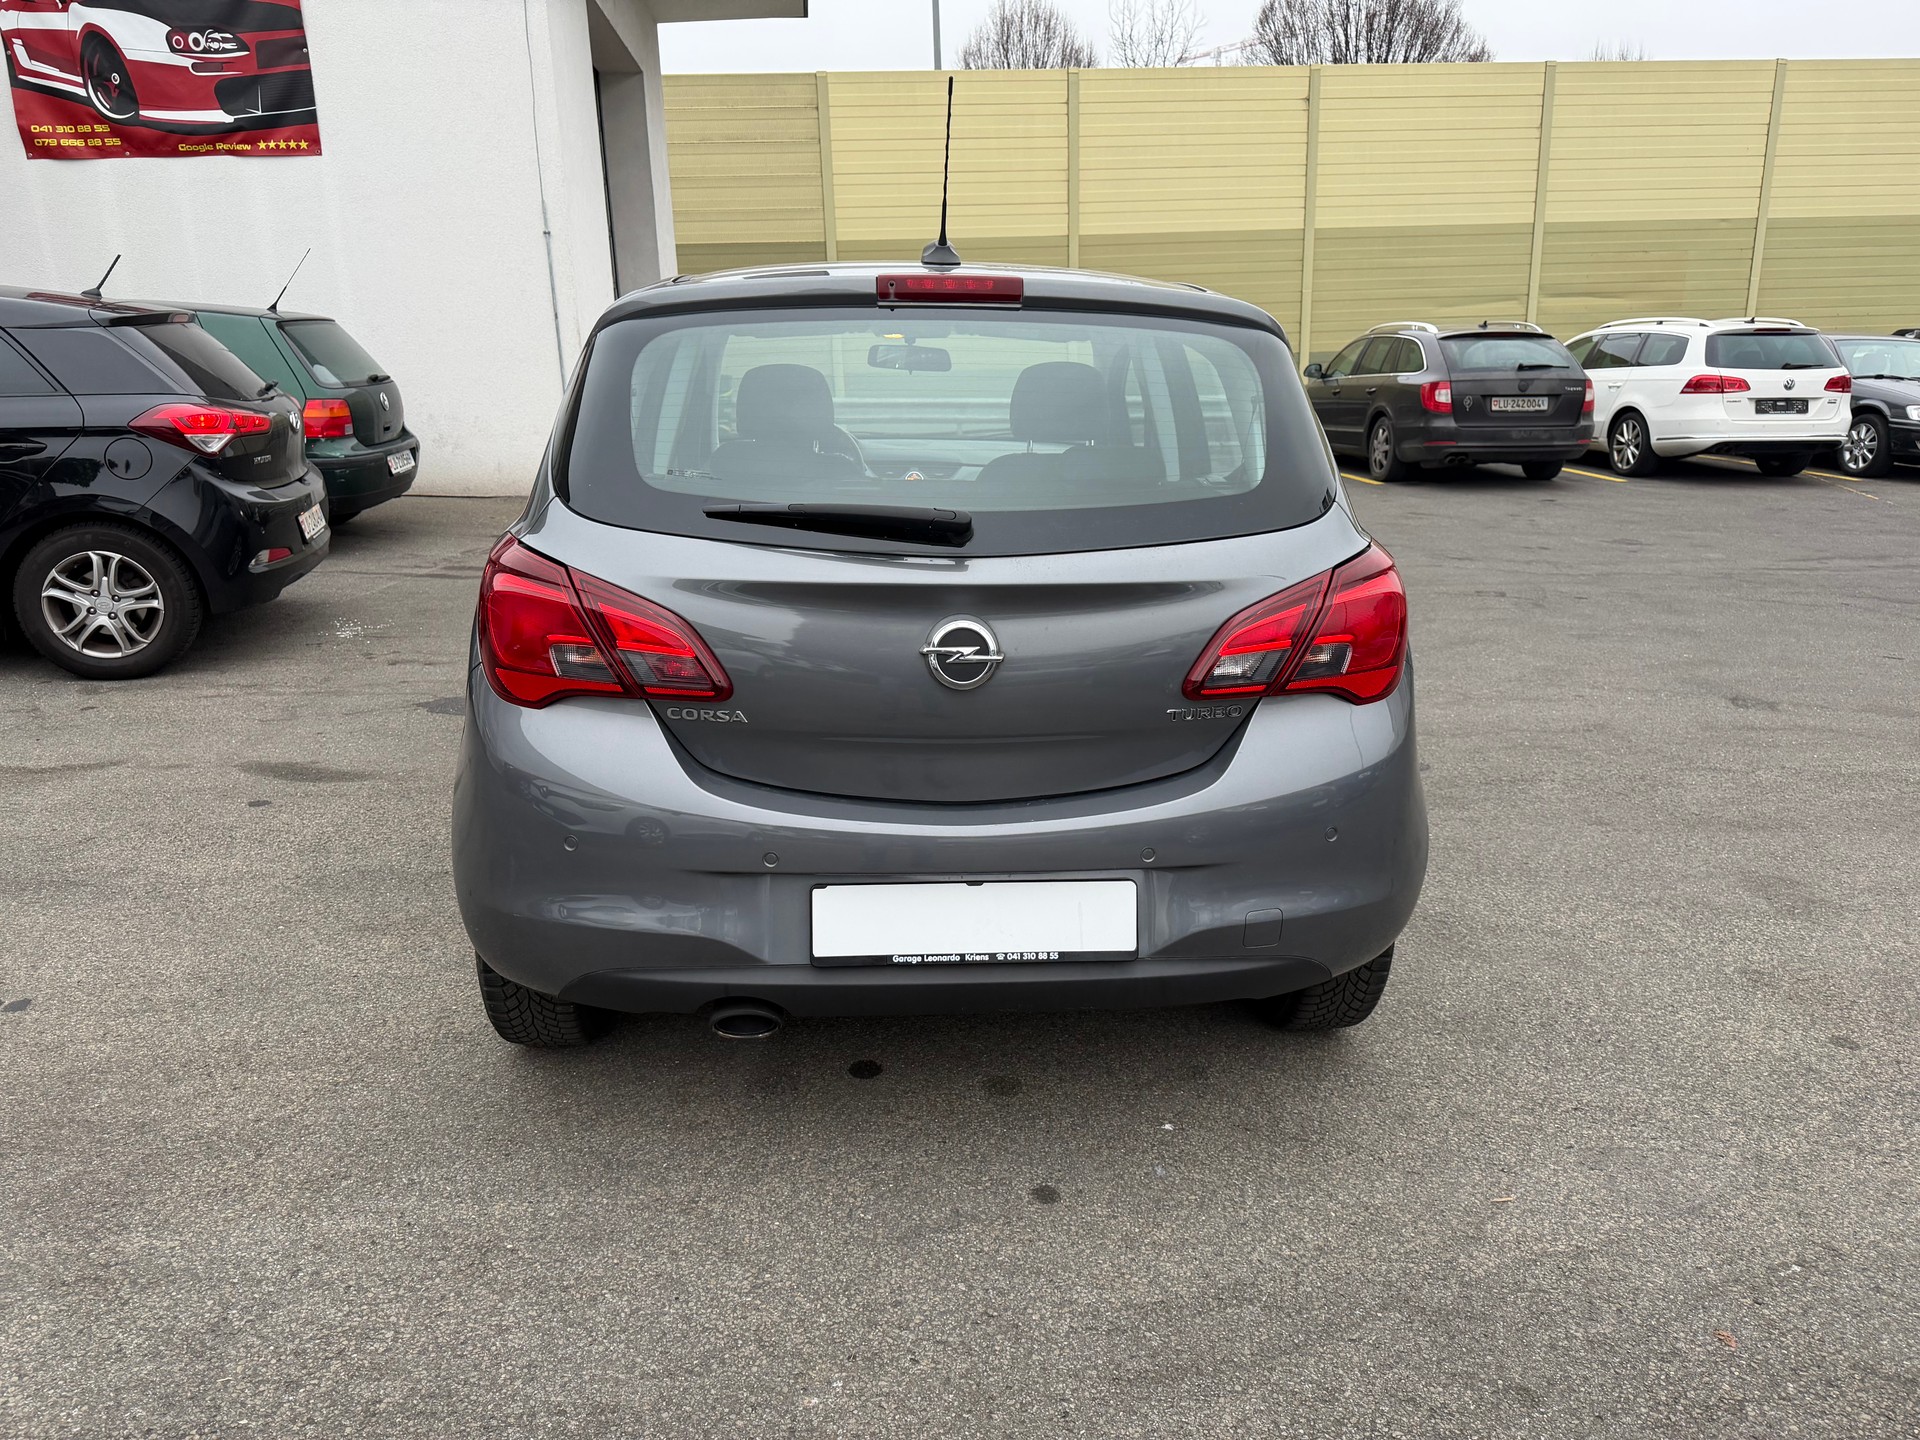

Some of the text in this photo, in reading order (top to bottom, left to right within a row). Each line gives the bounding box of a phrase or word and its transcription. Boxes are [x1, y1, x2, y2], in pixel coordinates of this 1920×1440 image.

[31, 124, 110, 133] 041 310 88 55
[34, 138, 121, 147] 079 666 88 55
[178, 142, 252, 153] Google Review
[666, 707, 748, 723] CORSA
[1166, 704, 1243, 721] TURBO
[892, 951, 1059, 964] Garage Leonardo Kriens 041 310 88 55
